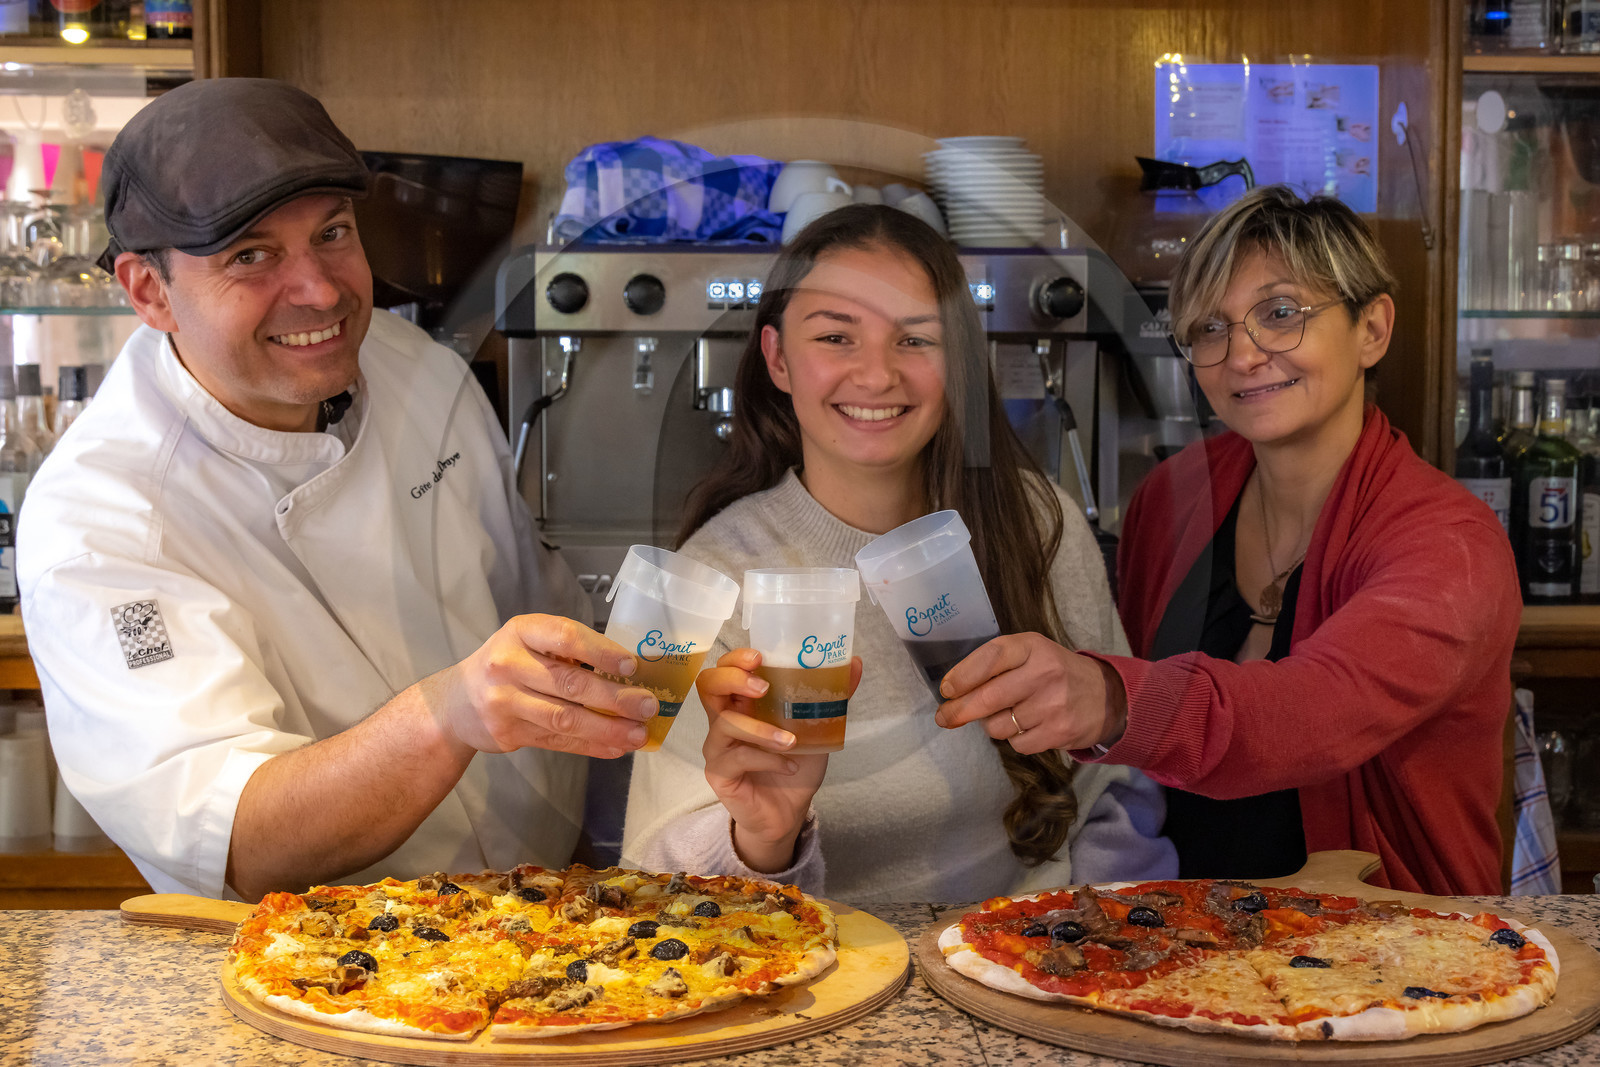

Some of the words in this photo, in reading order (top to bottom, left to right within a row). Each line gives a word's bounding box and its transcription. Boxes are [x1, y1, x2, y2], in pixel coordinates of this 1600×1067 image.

[432, 471, 443, 483] de
[1539, 493, 1569, 523] 51
[906, 593, 950, 637] Esprit
[933, 604, 958, 623] PARC
[637, 629, 696, 662] Esprit
[667, 653, 692, 662] PARC
[797, 634, 847, 669] Esprit
[827, 648, 847, 660] PARC
